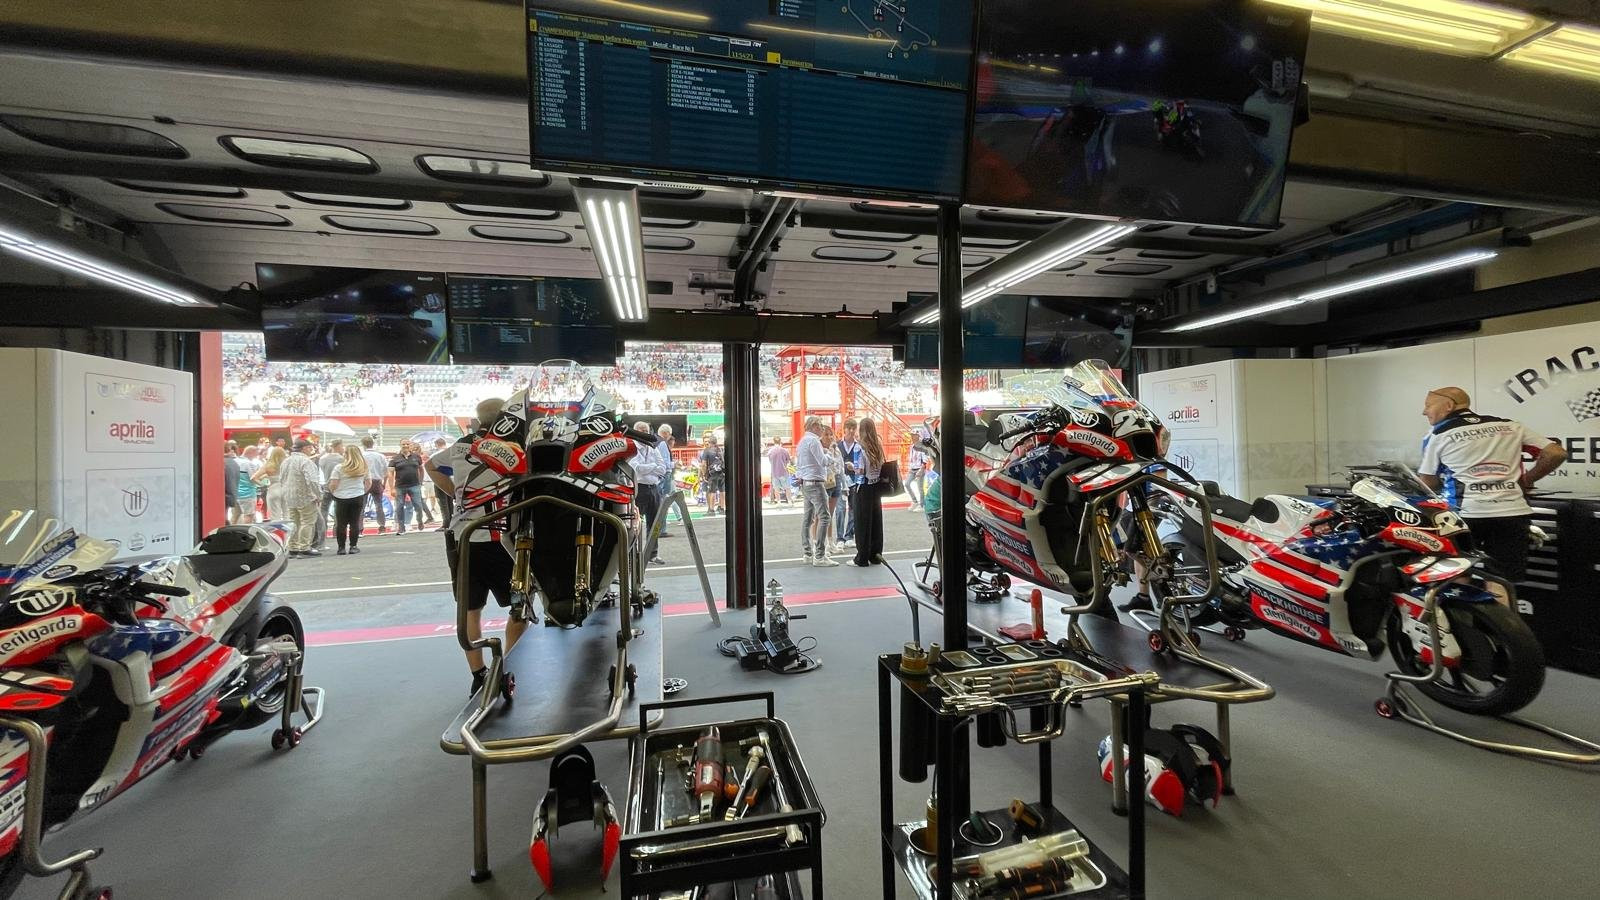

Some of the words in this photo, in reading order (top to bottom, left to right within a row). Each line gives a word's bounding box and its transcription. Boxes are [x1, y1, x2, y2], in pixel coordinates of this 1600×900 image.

[1168, 406, 1199, 421] aprilia
[110, 420, 155, 441] aprilia
[1448, 425, 1513, 443] TRACKHOUSE
[583, 438, 625, 466] sterilgarda
[1069, 431, 1116, 454] sterilgarda
[483, 441, 517, 468] sterilgarda
[1469, 481, 1516, 493] aprilia
[1395, 528, 1440, 548] sterilgarda
[28, 544, 75, 576] TRACKHOUSE
[1263, 607, 1318, 637] sterilgarda
